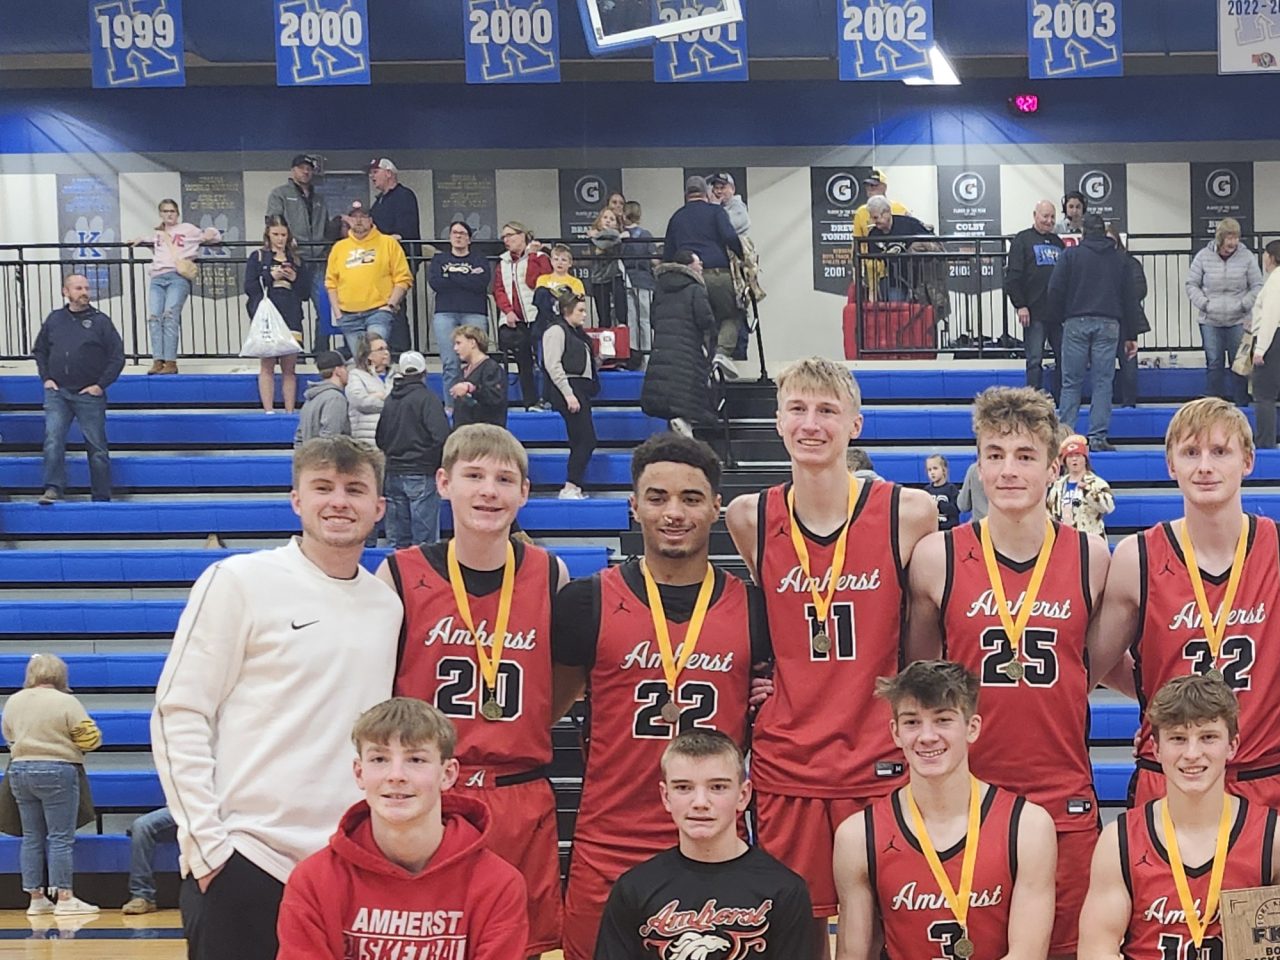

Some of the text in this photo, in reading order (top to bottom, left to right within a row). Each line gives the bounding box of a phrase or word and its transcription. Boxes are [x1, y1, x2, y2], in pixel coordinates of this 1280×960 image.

[96, 13, 175, 49] 1999
[280, 11, 362, 47] 2000
[469, 8, 552, 44] 2000
[843, 5, 926, 41] 2002
[1033, 3, 1115, 39] 2003
[956, 223, 985, 231] COLBY
[823, 266, 846, 278] 2001
[805, 601, 857, 662] 11
[620, 641, 734, 674] Amerst
[979, 626, 1060, 688] 25
[433, 656, 524, 722] 20
[631, 679, 719, 741] 22
[891, 882, 1003, 911] Amhrst
[352, 907, 464, 937] AMHERST
[639, 899, 774, 938] Amherst
